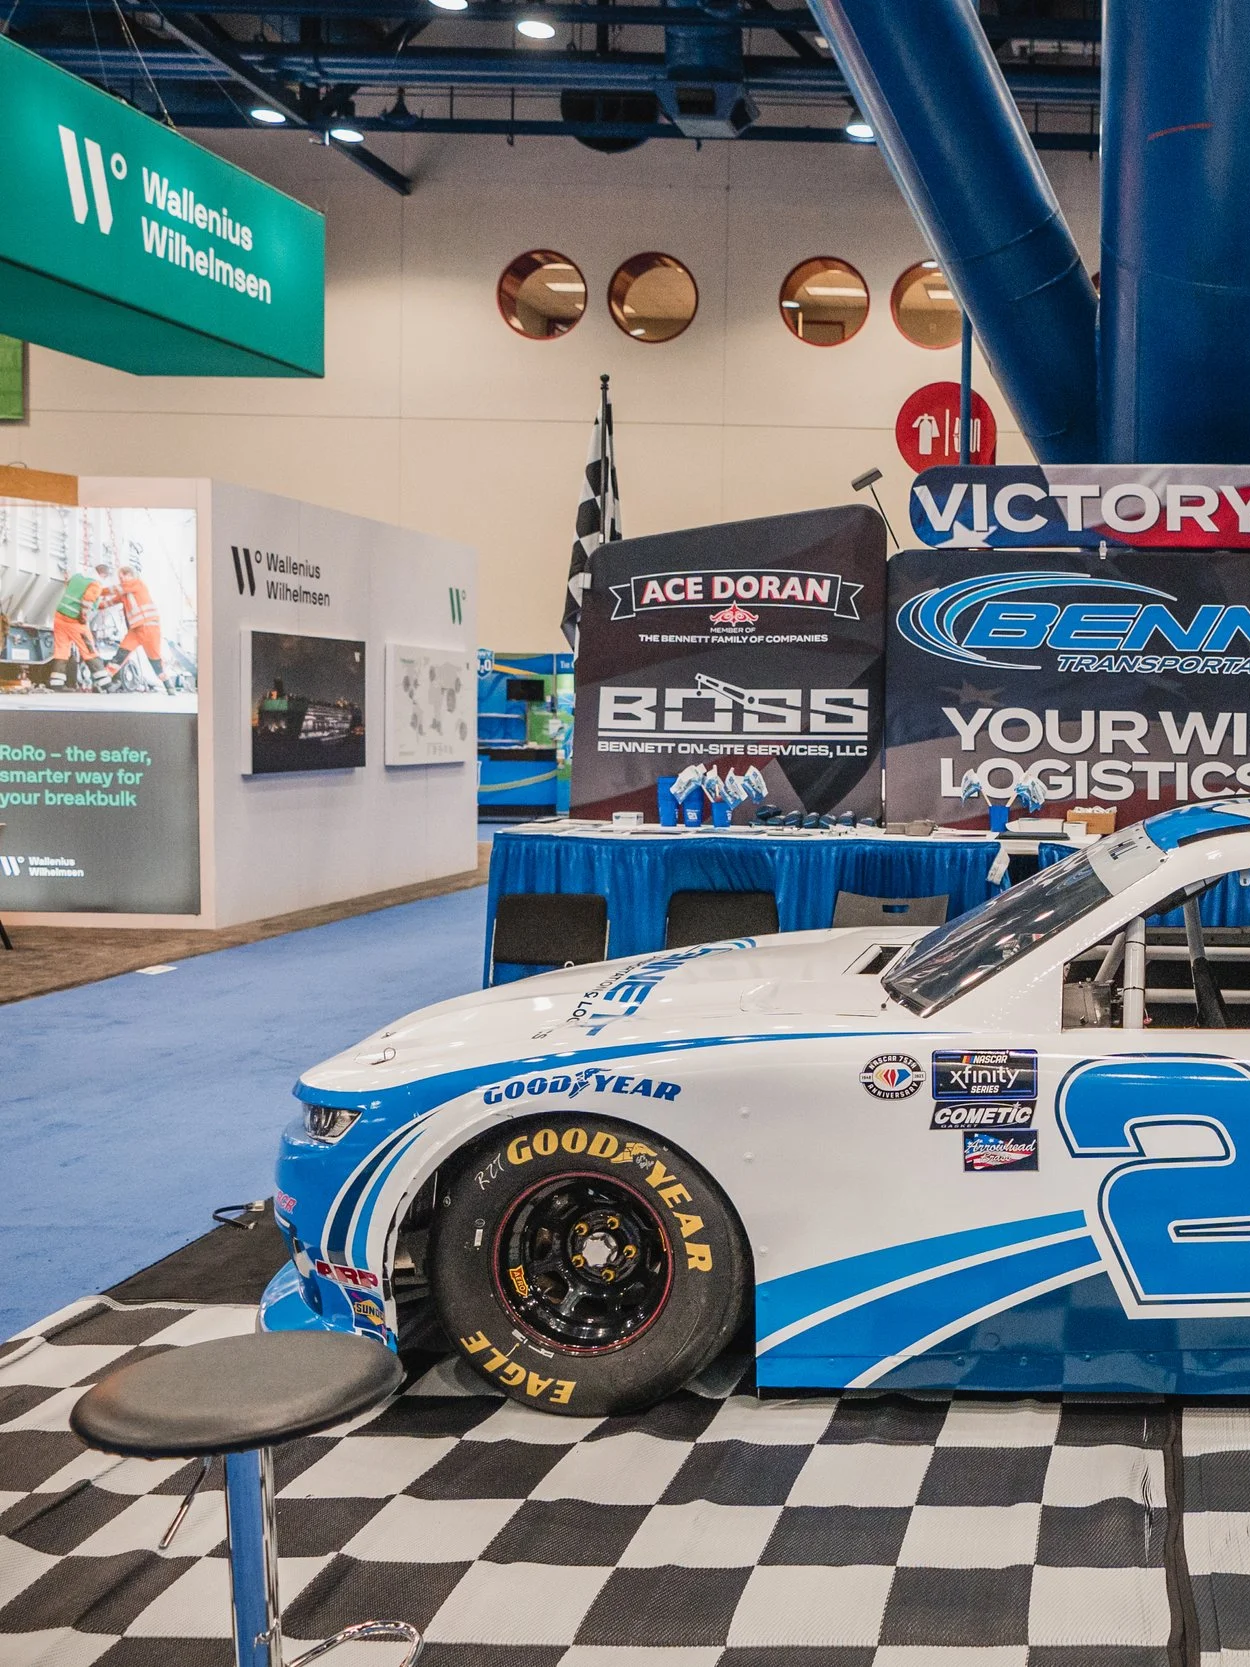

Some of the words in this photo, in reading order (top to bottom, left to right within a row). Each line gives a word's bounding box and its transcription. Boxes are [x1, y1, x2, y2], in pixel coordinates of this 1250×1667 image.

[142, 166, 253, 252] Wallenius
[141, 216, 272, 304] Wilhelmsen
[266, 552, 321, 580] Wallenius
[266, 579, 331, 607] Wilhelmsen
[640, 576, 703, 605] ACE
[711, 575, 832, 604] DORAN
[638, 634, 659, 642] THE
[661, 634, 710, 643] BENNETT
[711, 635, 749, 643] FAMILY
[750, 635, 764, 643] OF
[765, 634, 829, 643] COMPANIES
[598, 686, 869, 733] BOSS
[941, 706, 1151, 755] YOUR
[0, 744, 46, 761] RoRo
[65, 746, 97, 762] the
[100, 747, 152, 766] safer,
[598, 741, 676, 754] BENNETT
[678, 742, 744, 756] ON-SITE
[747, 743, 833, 758] SERVICES,
[836, 745, 868, 757] LLC
[0, 768, 72, 784] smarter
[75, 771, 113, 788] way
[117, 769, 143, 785] for
[0, 793, 40, 808] your
[45, 789, 137, 807] breakbulk
[28, 856, 76, 866] Wallenius
[28, 867, 84, 877] Wilhelmsen
[868, 1055, 897, 1070] NASCAR
[898, 1055, 918, 1069] 75TH
[973, 1055, 1008, 1064] NASCAR
[950, 1064, 1020, 1089] xfinity
[867, 1082, 919, 1099] ANNIVERSARY
[970, 1085, 1000, 1094] SERIES
[934, 1105, 1032, 1125] COMETIC
[964, 1138, 1036, 1154] Arrowhead
[512, 1270, 527, 1295] AERO
[460, 1330, 577, 1404] EAGLE
